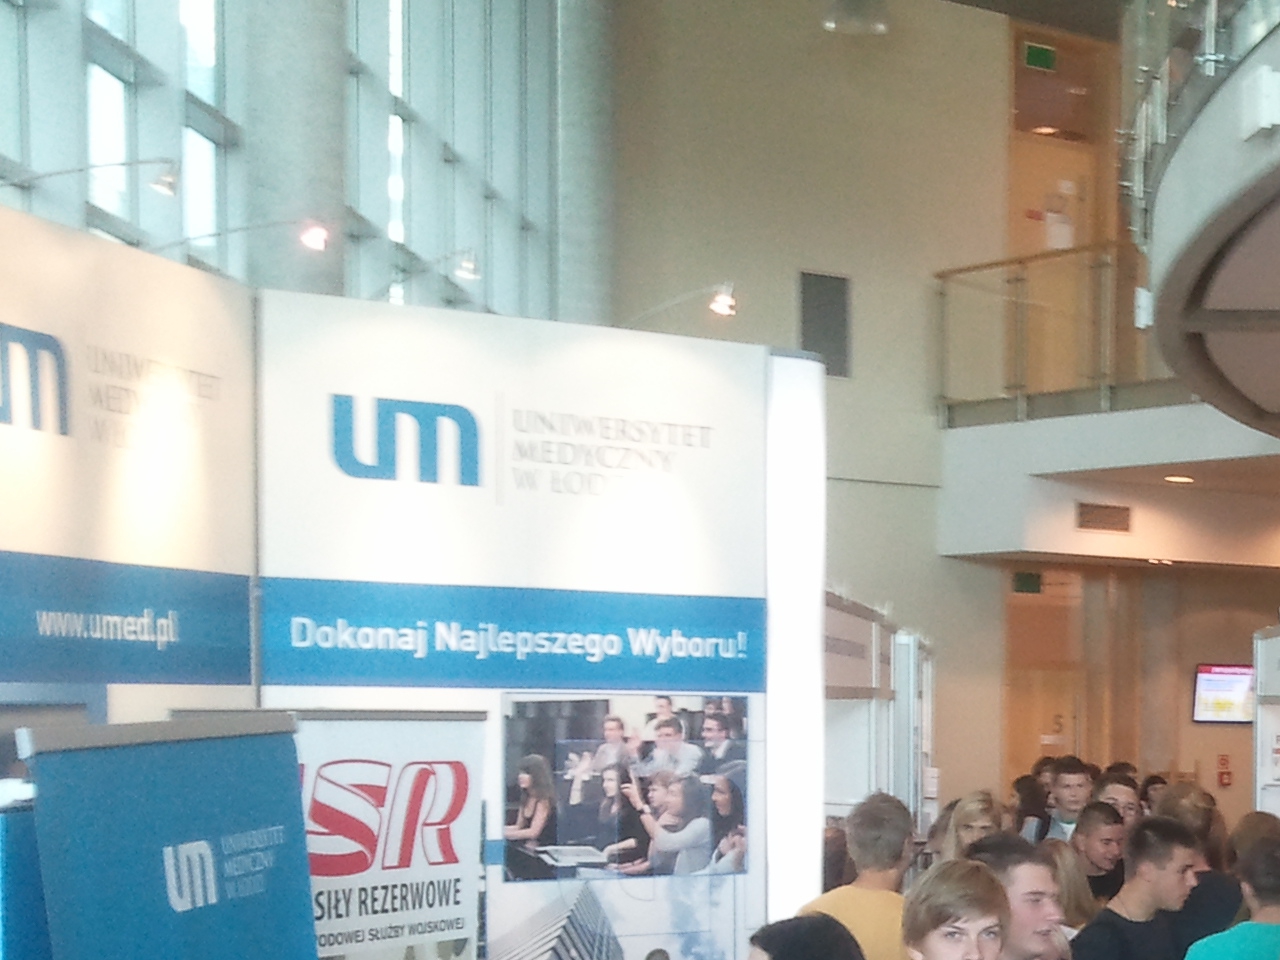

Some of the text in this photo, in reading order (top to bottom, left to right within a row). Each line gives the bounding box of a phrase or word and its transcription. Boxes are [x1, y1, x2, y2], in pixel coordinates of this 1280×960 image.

[511, 408, 716, 449] UNIWERSYTET
[36, 608, 179, 650] www.umed.pl
[291, 617, 748, 664] Dokonaj Najlepszego Wyboru!
[299, 758, 469, 877] SR
[315, 877, 462, 921] SIŁY REZERWOWE
[318, 929, 365, 948] ODOWEJ
[408, 917, 465, 937] WOJSKOWEJ
